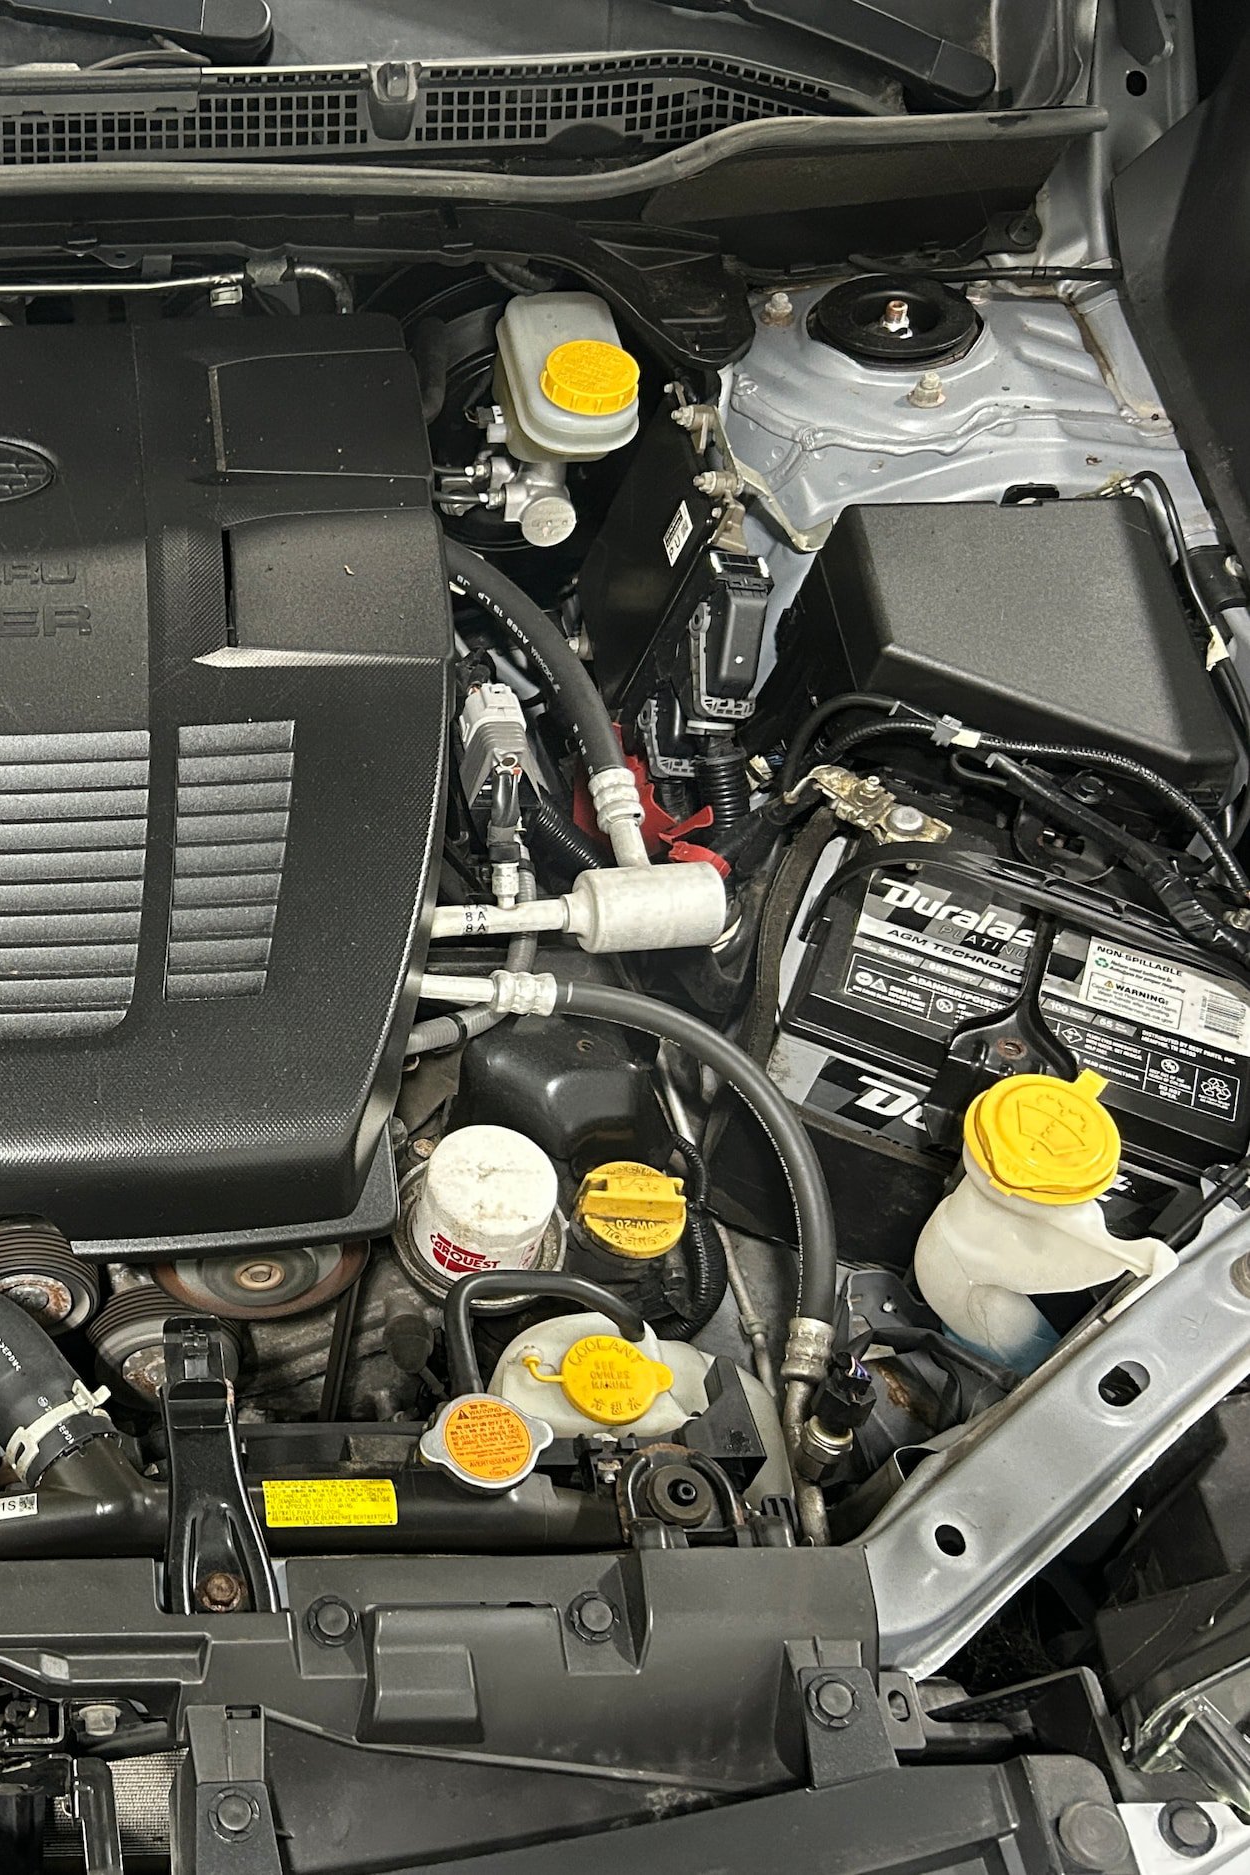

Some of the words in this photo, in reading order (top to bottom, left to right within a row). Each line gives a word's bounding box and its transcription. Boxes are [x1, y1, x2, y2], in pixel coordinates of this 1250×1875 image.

[477, 591, 491, 605] LP
[881, 877, 1037, 948] Duralas
[887, 928, 930, 946] AGM
[932, 942, 1023, 976] TECHNOLO
[939, 924, 1029, 961] PLATINU
[1097, 946, 1183, 977] NON-SPILLABLE
[1049, 1002, 1068, 1014] 100
[615, 1219, 655, 1230] 0W-20
[568, 1338, 645, 1366] COOLANT
